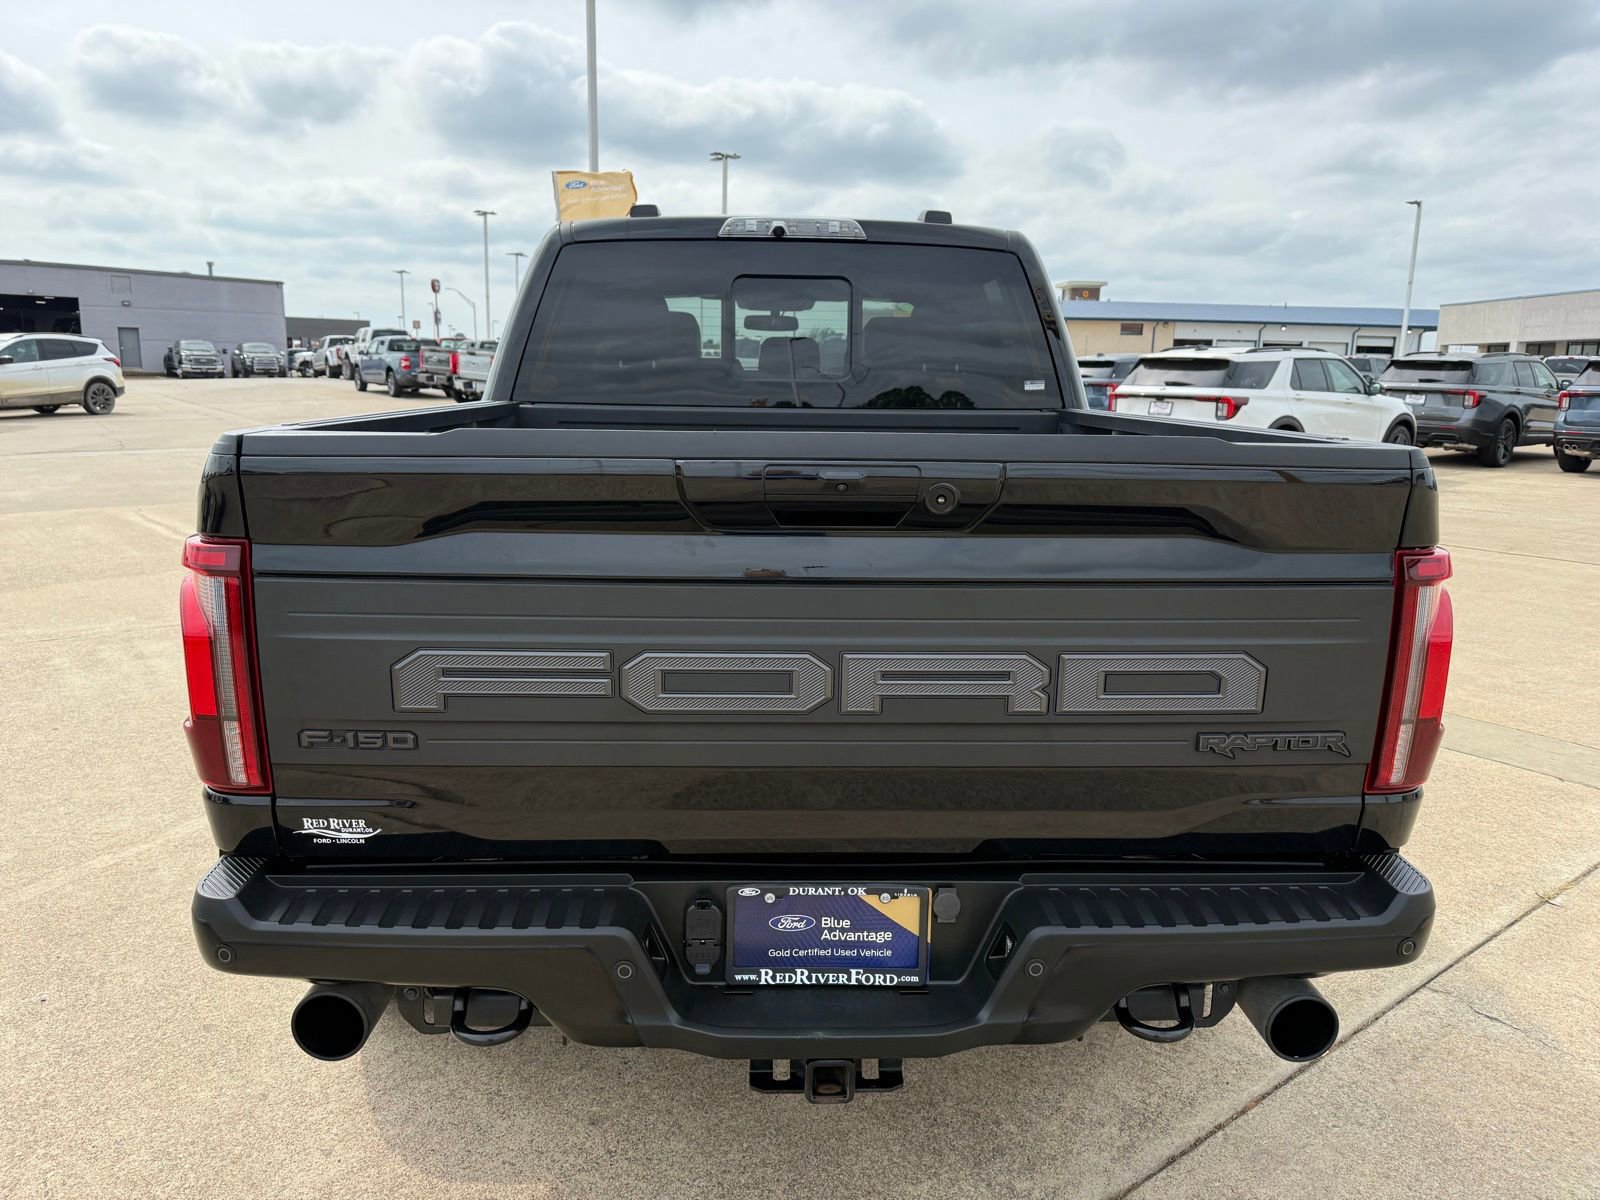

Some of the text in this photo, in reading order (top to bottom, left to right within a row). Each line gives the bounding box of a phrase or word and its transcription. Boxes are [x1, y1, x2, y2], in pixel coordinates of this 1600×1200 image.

[391, 648, 1268, 715] FORD
[298, 729, 418, 750] F-150
[1195, 731, 1351, 759] RAPTOR
[302, 817, 367, 829] RED RIVER
[789, 887, 867, 897] DURANT, OK
[777, 916, 807, 929] Ford
[821, 917, 851, 928] Blue
[820, 929, 893, 943] Advantage
[768, 948, 893, 957] Gold Certified Used Vehicle
